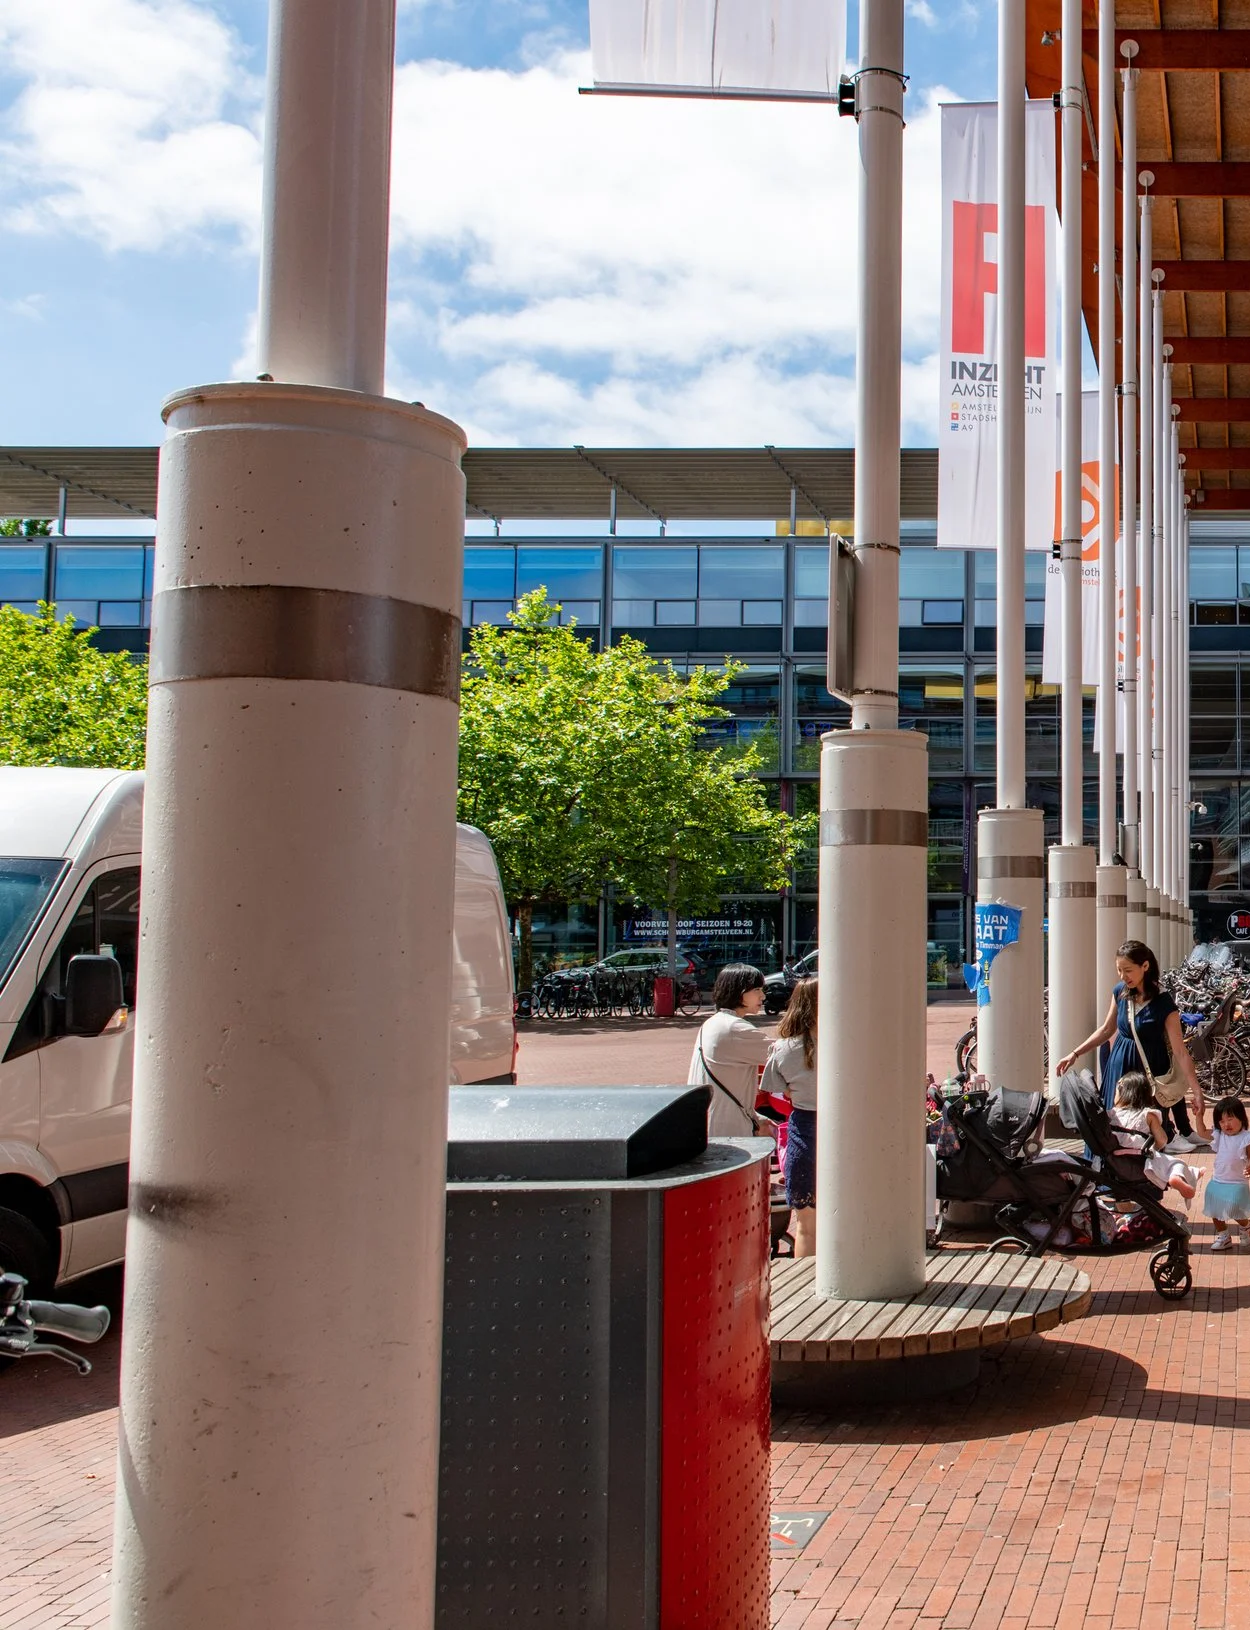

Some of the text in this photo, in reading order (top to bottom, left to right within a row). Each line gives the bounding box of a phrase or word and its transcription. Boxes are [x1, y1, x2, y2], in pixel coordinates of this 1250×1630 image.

[951, 361, 1046, 385] INZIHT
[951, 383, 1042, 400] AMSTEEN
[983, 914, 1009, 925] VAN
